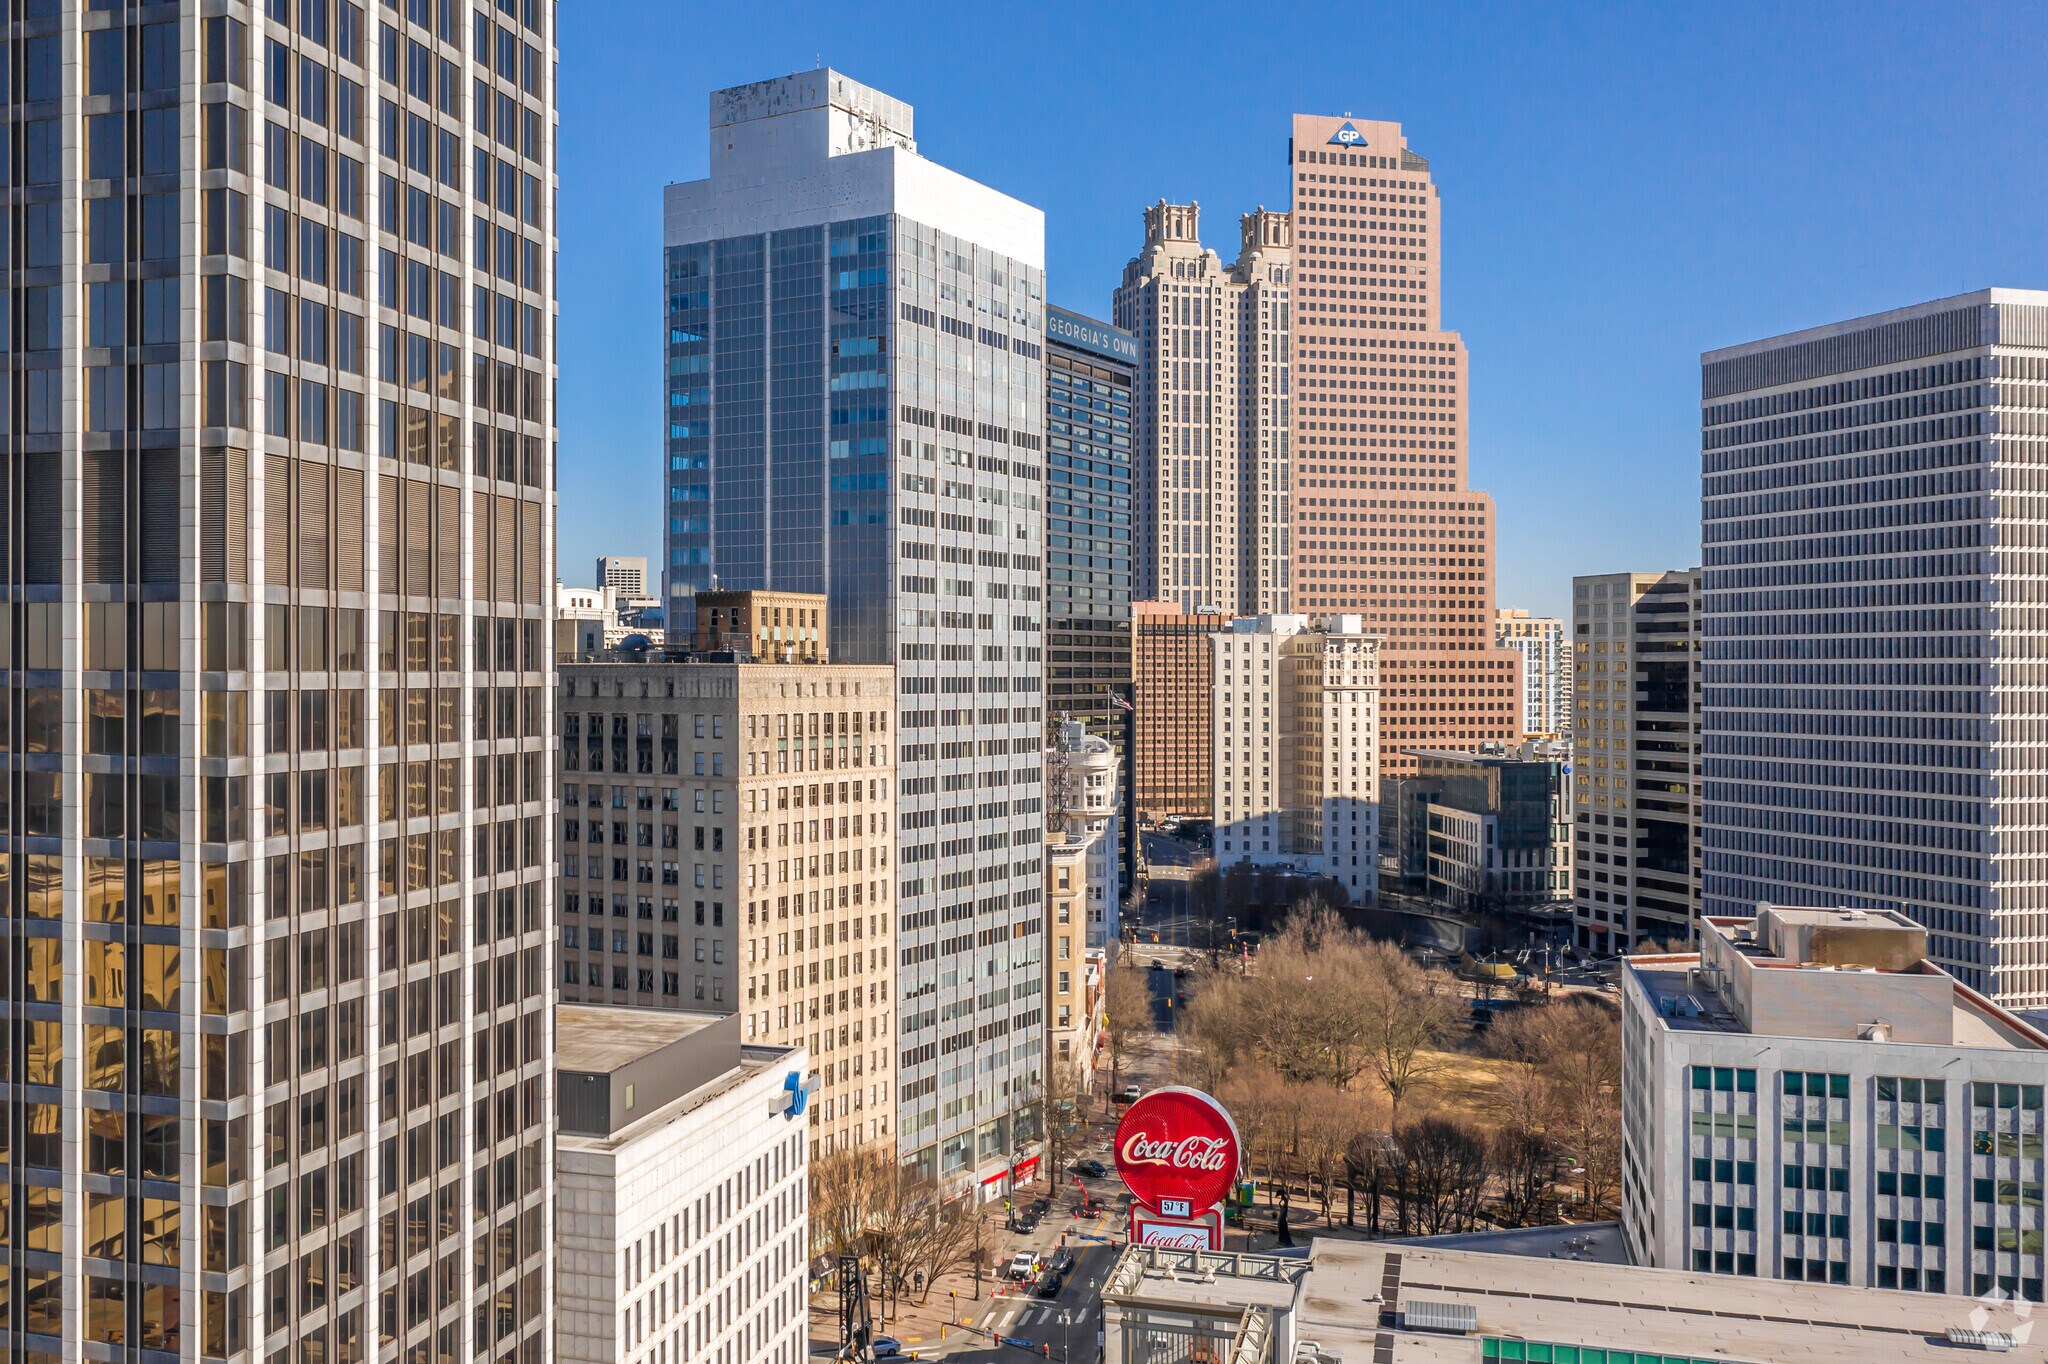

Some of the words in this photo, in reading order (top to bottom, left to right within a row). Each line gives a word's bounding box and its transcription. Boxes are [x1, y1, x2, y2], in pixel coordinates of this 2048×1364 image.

[1338, 130, 1360, 142] GP
[1049, 317, 1109, 349] GEORGIA'S
[1113, 338, 1137, 358] OWN
[1121, 1131, 1230, 1171] Coca-Cola
